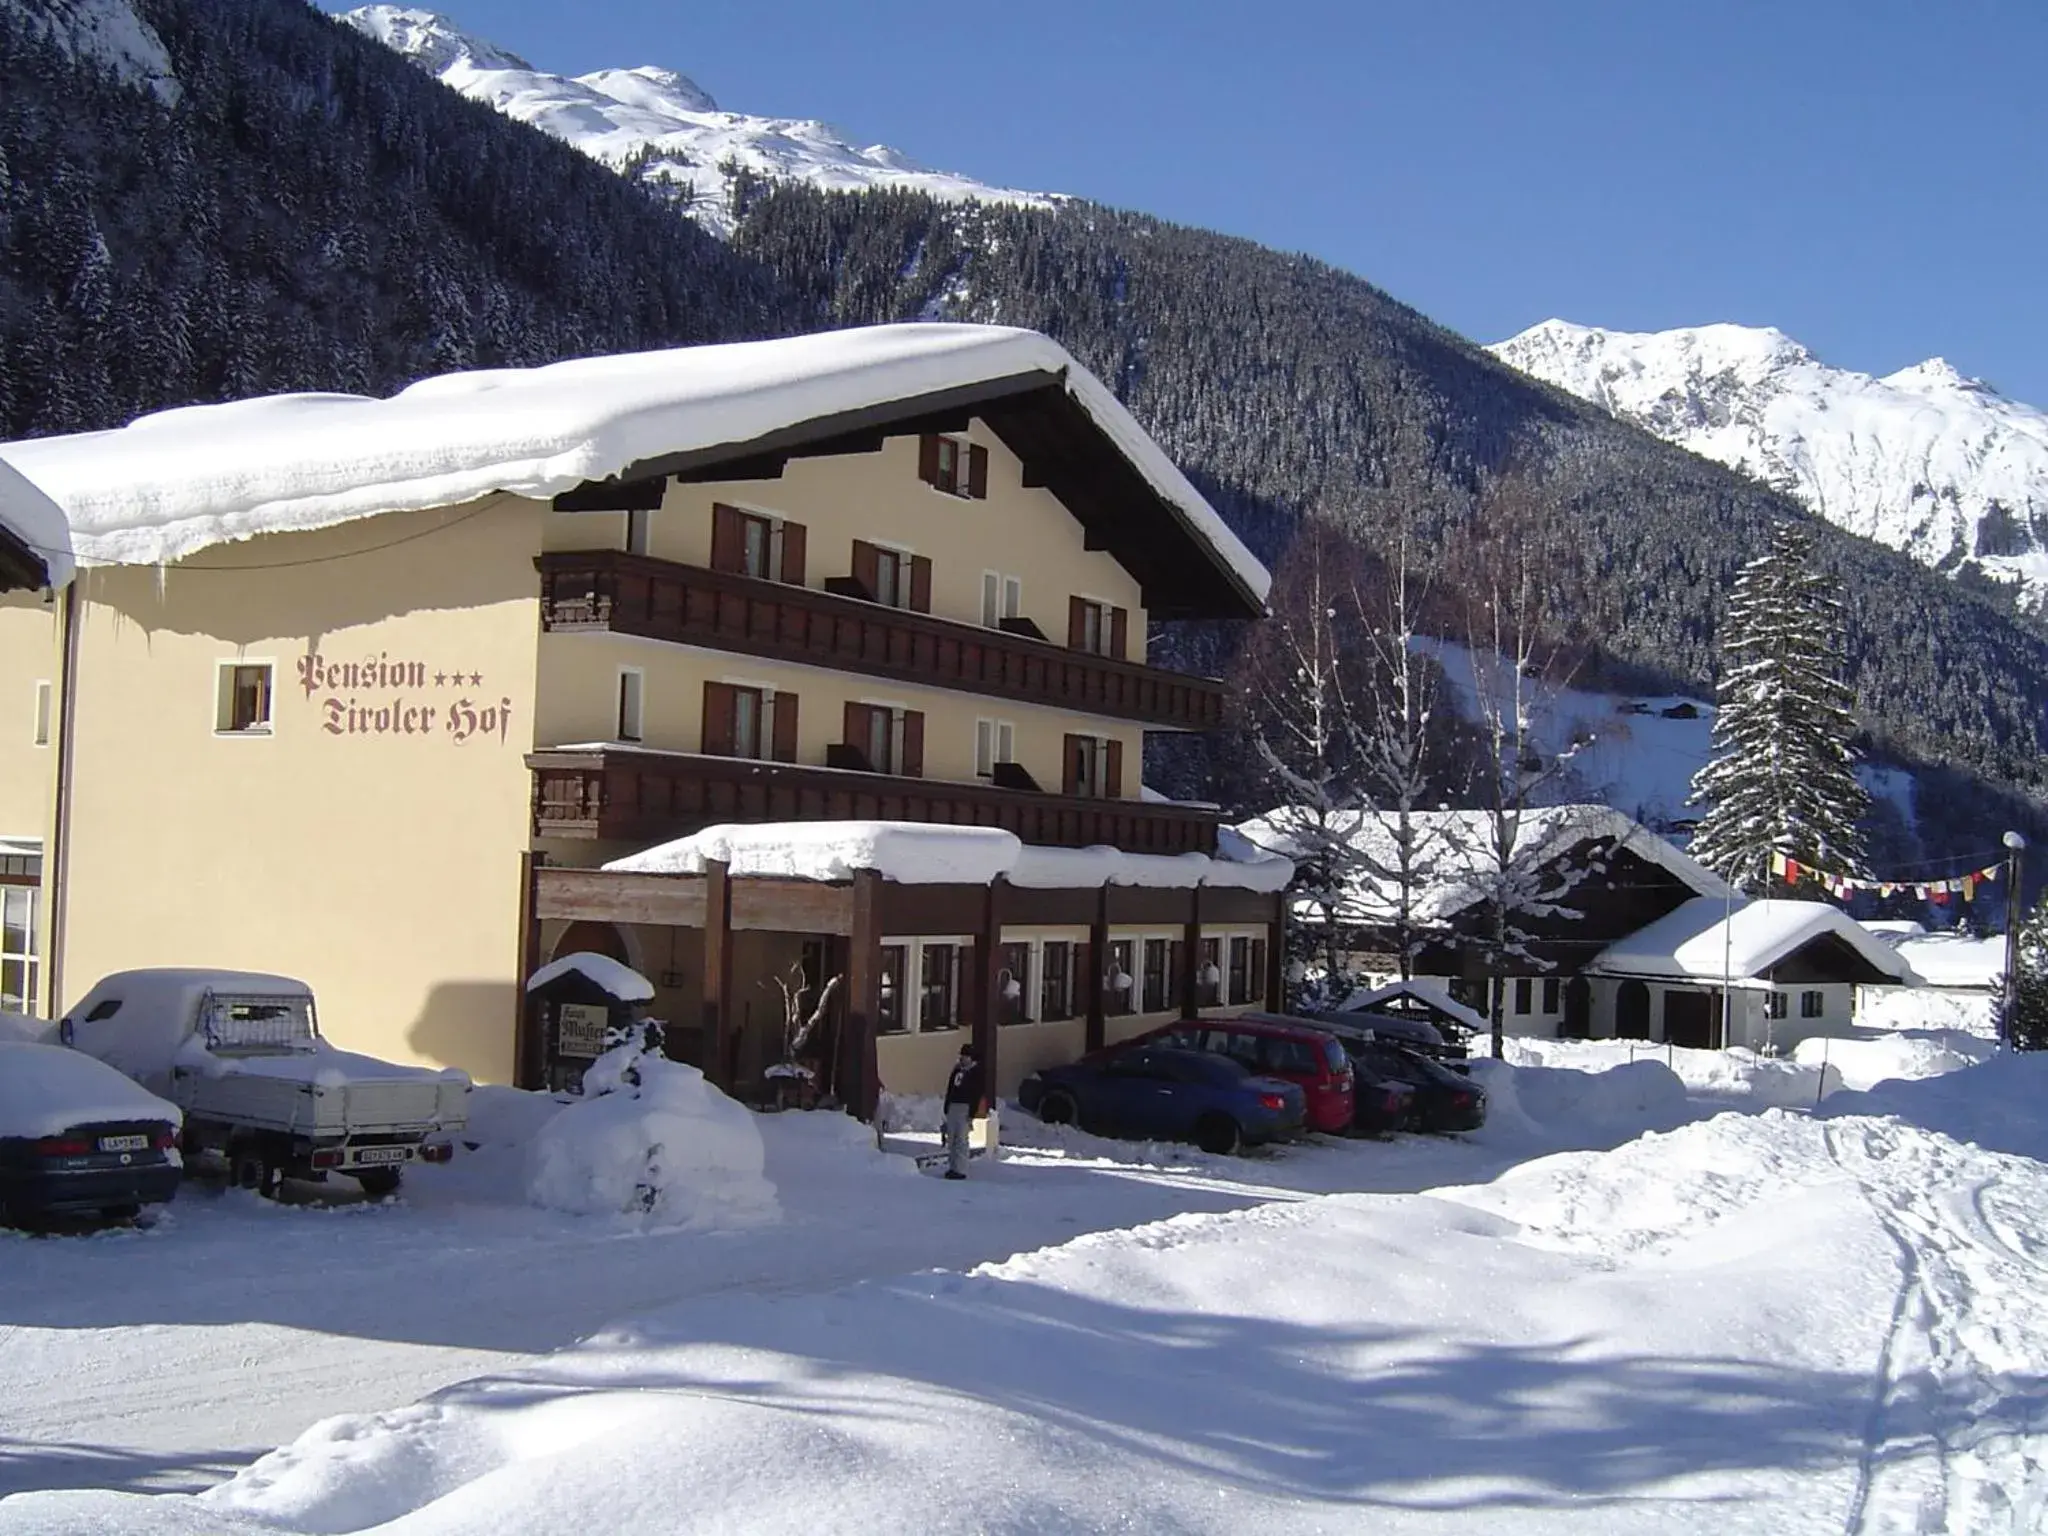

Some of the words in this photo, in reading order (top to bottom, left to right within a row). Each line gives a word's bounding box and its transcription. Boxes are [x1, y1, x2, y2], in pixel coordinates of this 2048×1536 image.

[297, 652, 425, 700] Pension
[323, 698, 436, 735] Tiroler
[446, 697, 512, 747] Hof
